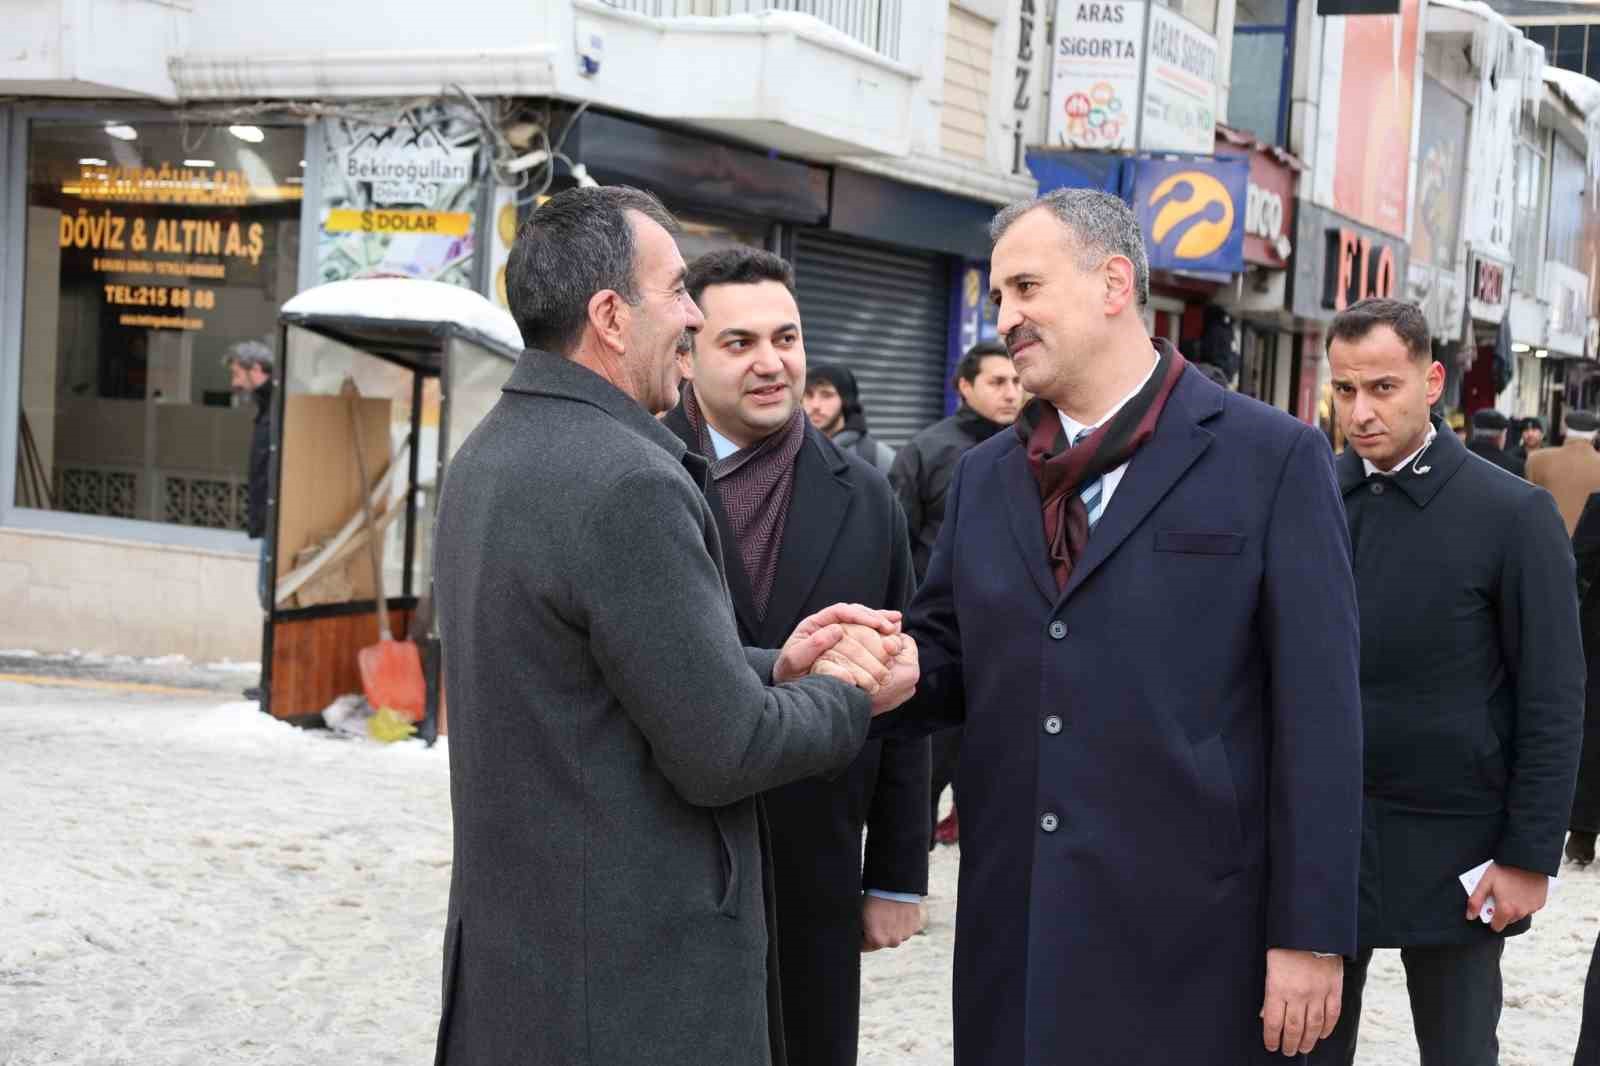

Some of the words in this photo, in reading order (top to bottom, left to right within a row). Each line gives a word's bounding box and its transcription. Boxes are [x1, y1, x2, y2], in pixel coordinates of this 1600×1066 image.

[1076, 3, 1125, 24] ARAS
[59, 209, 125, 249] DÖVİZ
[131, 217, 147, 251] &
[153, 219, 221, 255] ALTIN
[377, 213, 438, 232] DOLAR
